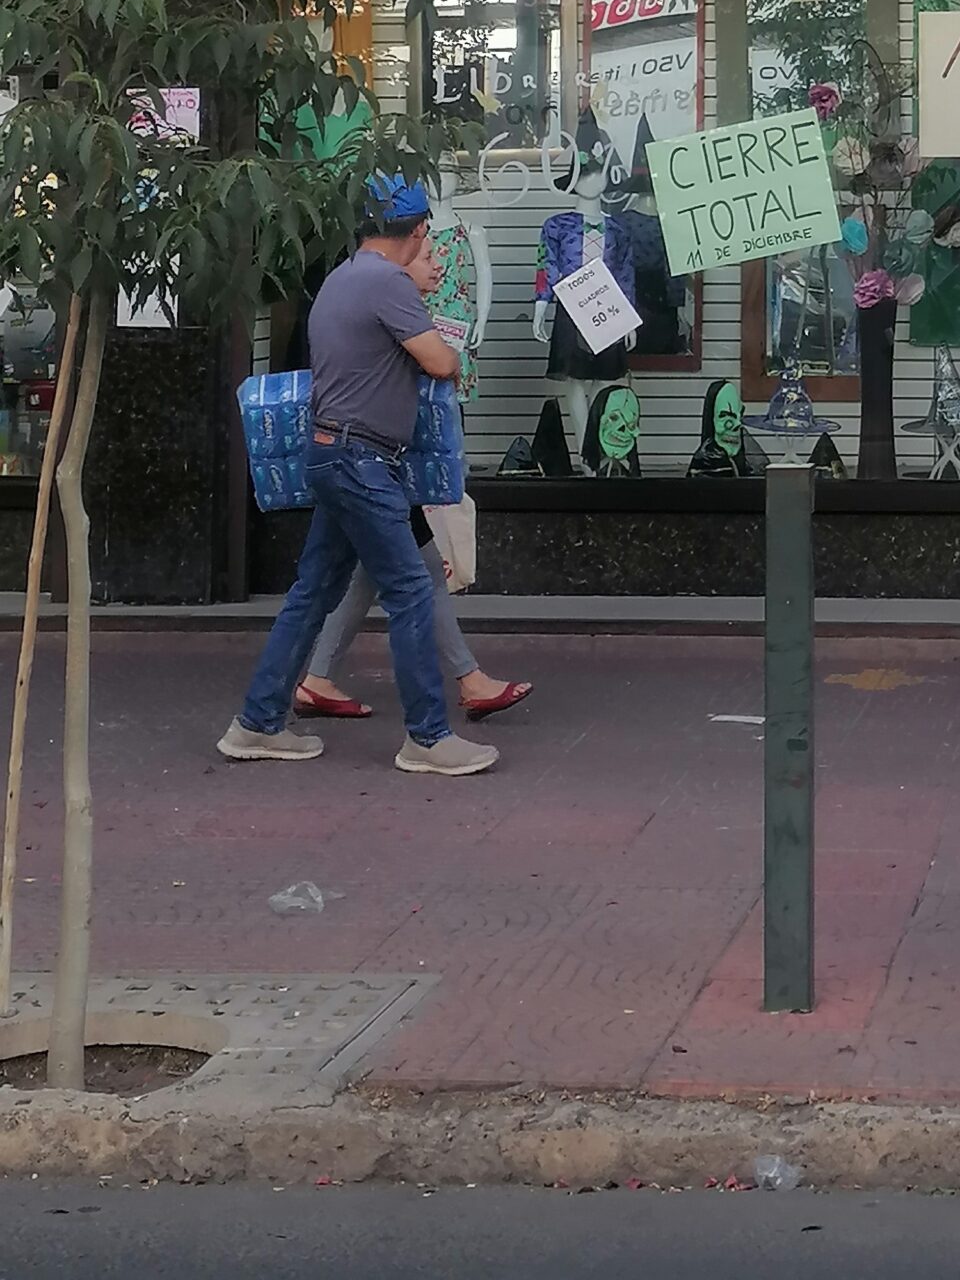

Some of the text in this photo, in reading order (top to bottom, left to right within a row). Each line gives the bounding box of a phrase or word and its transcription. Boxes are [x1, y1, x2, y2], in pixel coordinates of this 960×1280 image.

[669, 121, 819, 189] CIERRE
[677, 185, 822, 245] TOTAL
[687, 227, 812, 269] 11 DE DICIEMBRE
[568, 269, 596, 291] TODOS
[578, 284, 610, 308] CUADROS
[592, 311, 607, 328] 50
